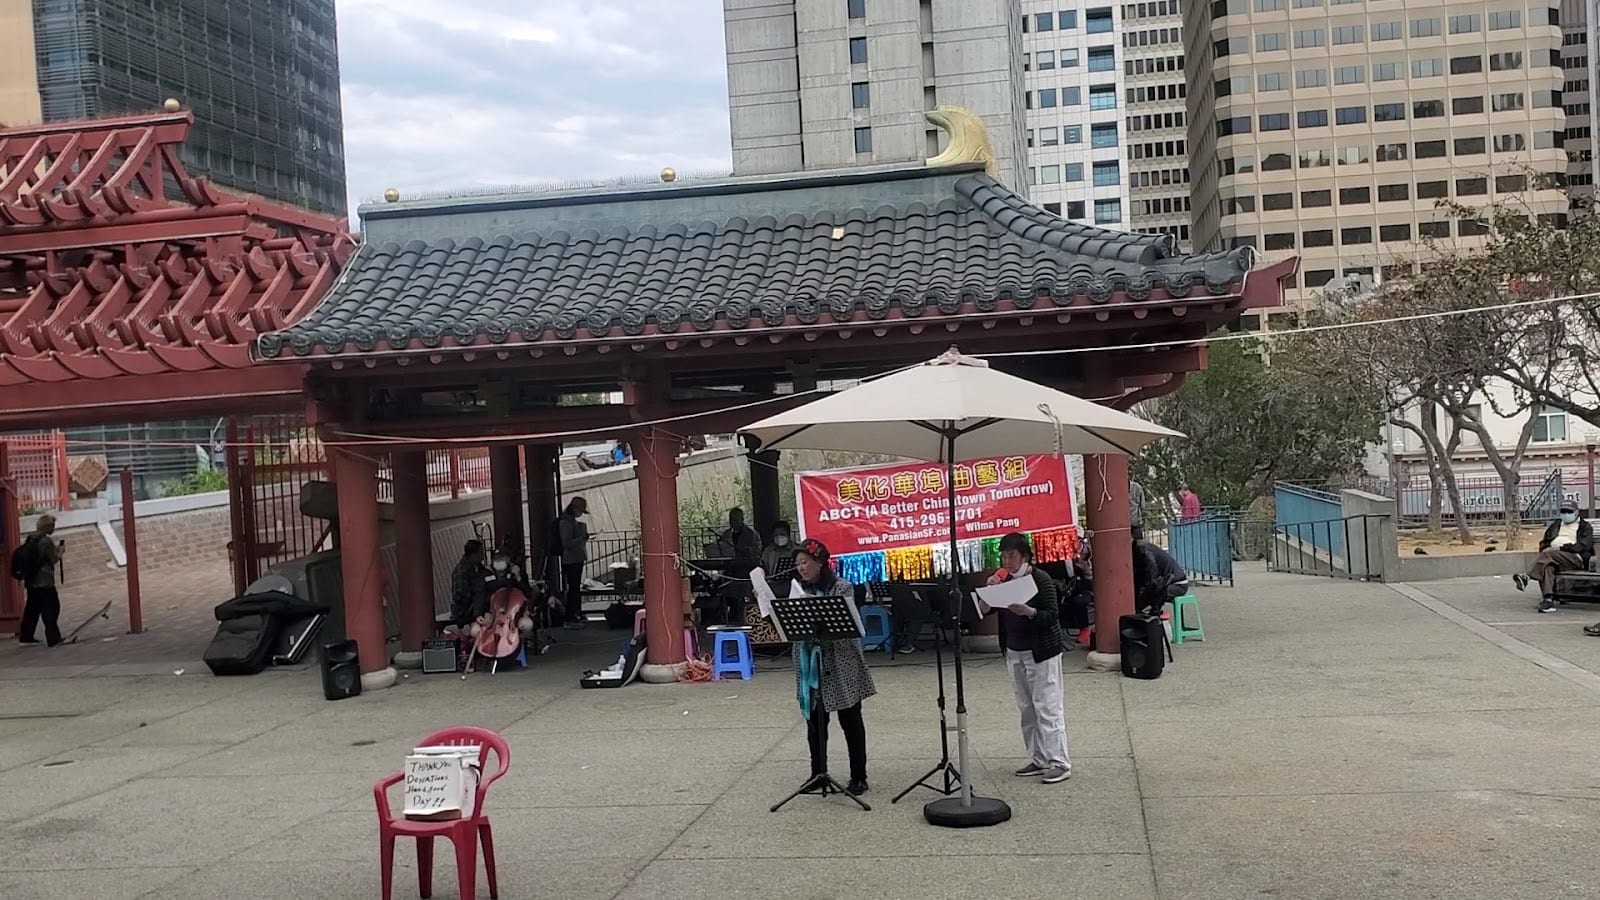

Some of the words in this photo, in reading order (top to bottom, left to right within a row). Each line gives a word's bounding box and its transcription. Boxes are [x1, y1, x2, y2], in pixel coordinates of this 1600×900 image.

[819, 507, 861, 522] ABCT
[865, 505, 878, 518] (A
[881, 502, 919, 515] Better
[989, 480, 1053, 500] Tomorrow)
[1457, 493, 1501, 506] arden
[965, 521, 994, 532] Wilma
[997, 518, 1020, 529] Pang
